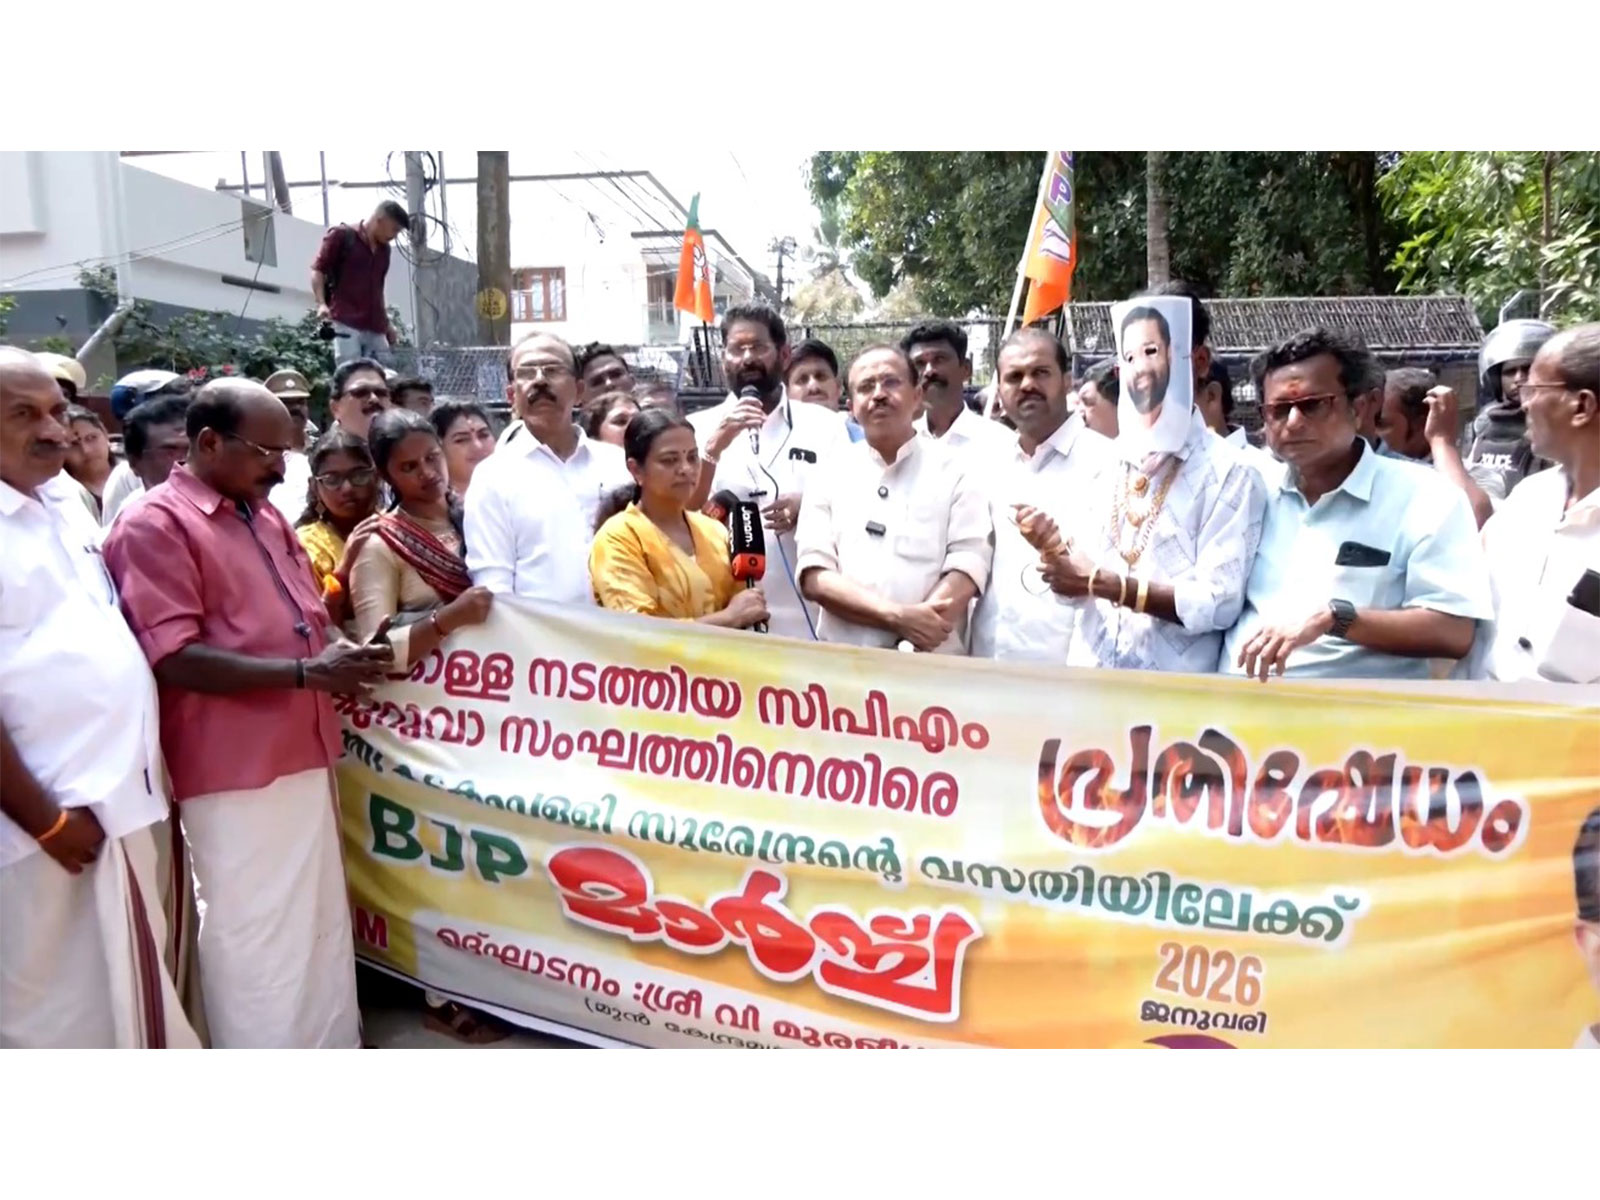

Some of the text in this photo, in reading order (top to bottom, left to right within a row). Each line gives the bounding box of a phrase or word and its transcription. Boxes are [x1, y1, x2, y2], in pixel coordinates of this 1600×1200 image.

[529, 658, 742, 719] നടത്തിയ
[758, 683, 990, 753] സിപിഎം
[500, 715, 959, 817] സംഘത്തിനെതിരെ
[1037, 724, 1523, 853] പ്രതിഷേധം
[369, 793, 528, 883] BJP
[919, 855, 1360, 942] വസതിയിലേക്ക്
[715, 1003, 760, 1032] വി
[1141, 1000, 1267, 1034] ജനുവരി
[1155, 942, 1262, 1007] 2026
